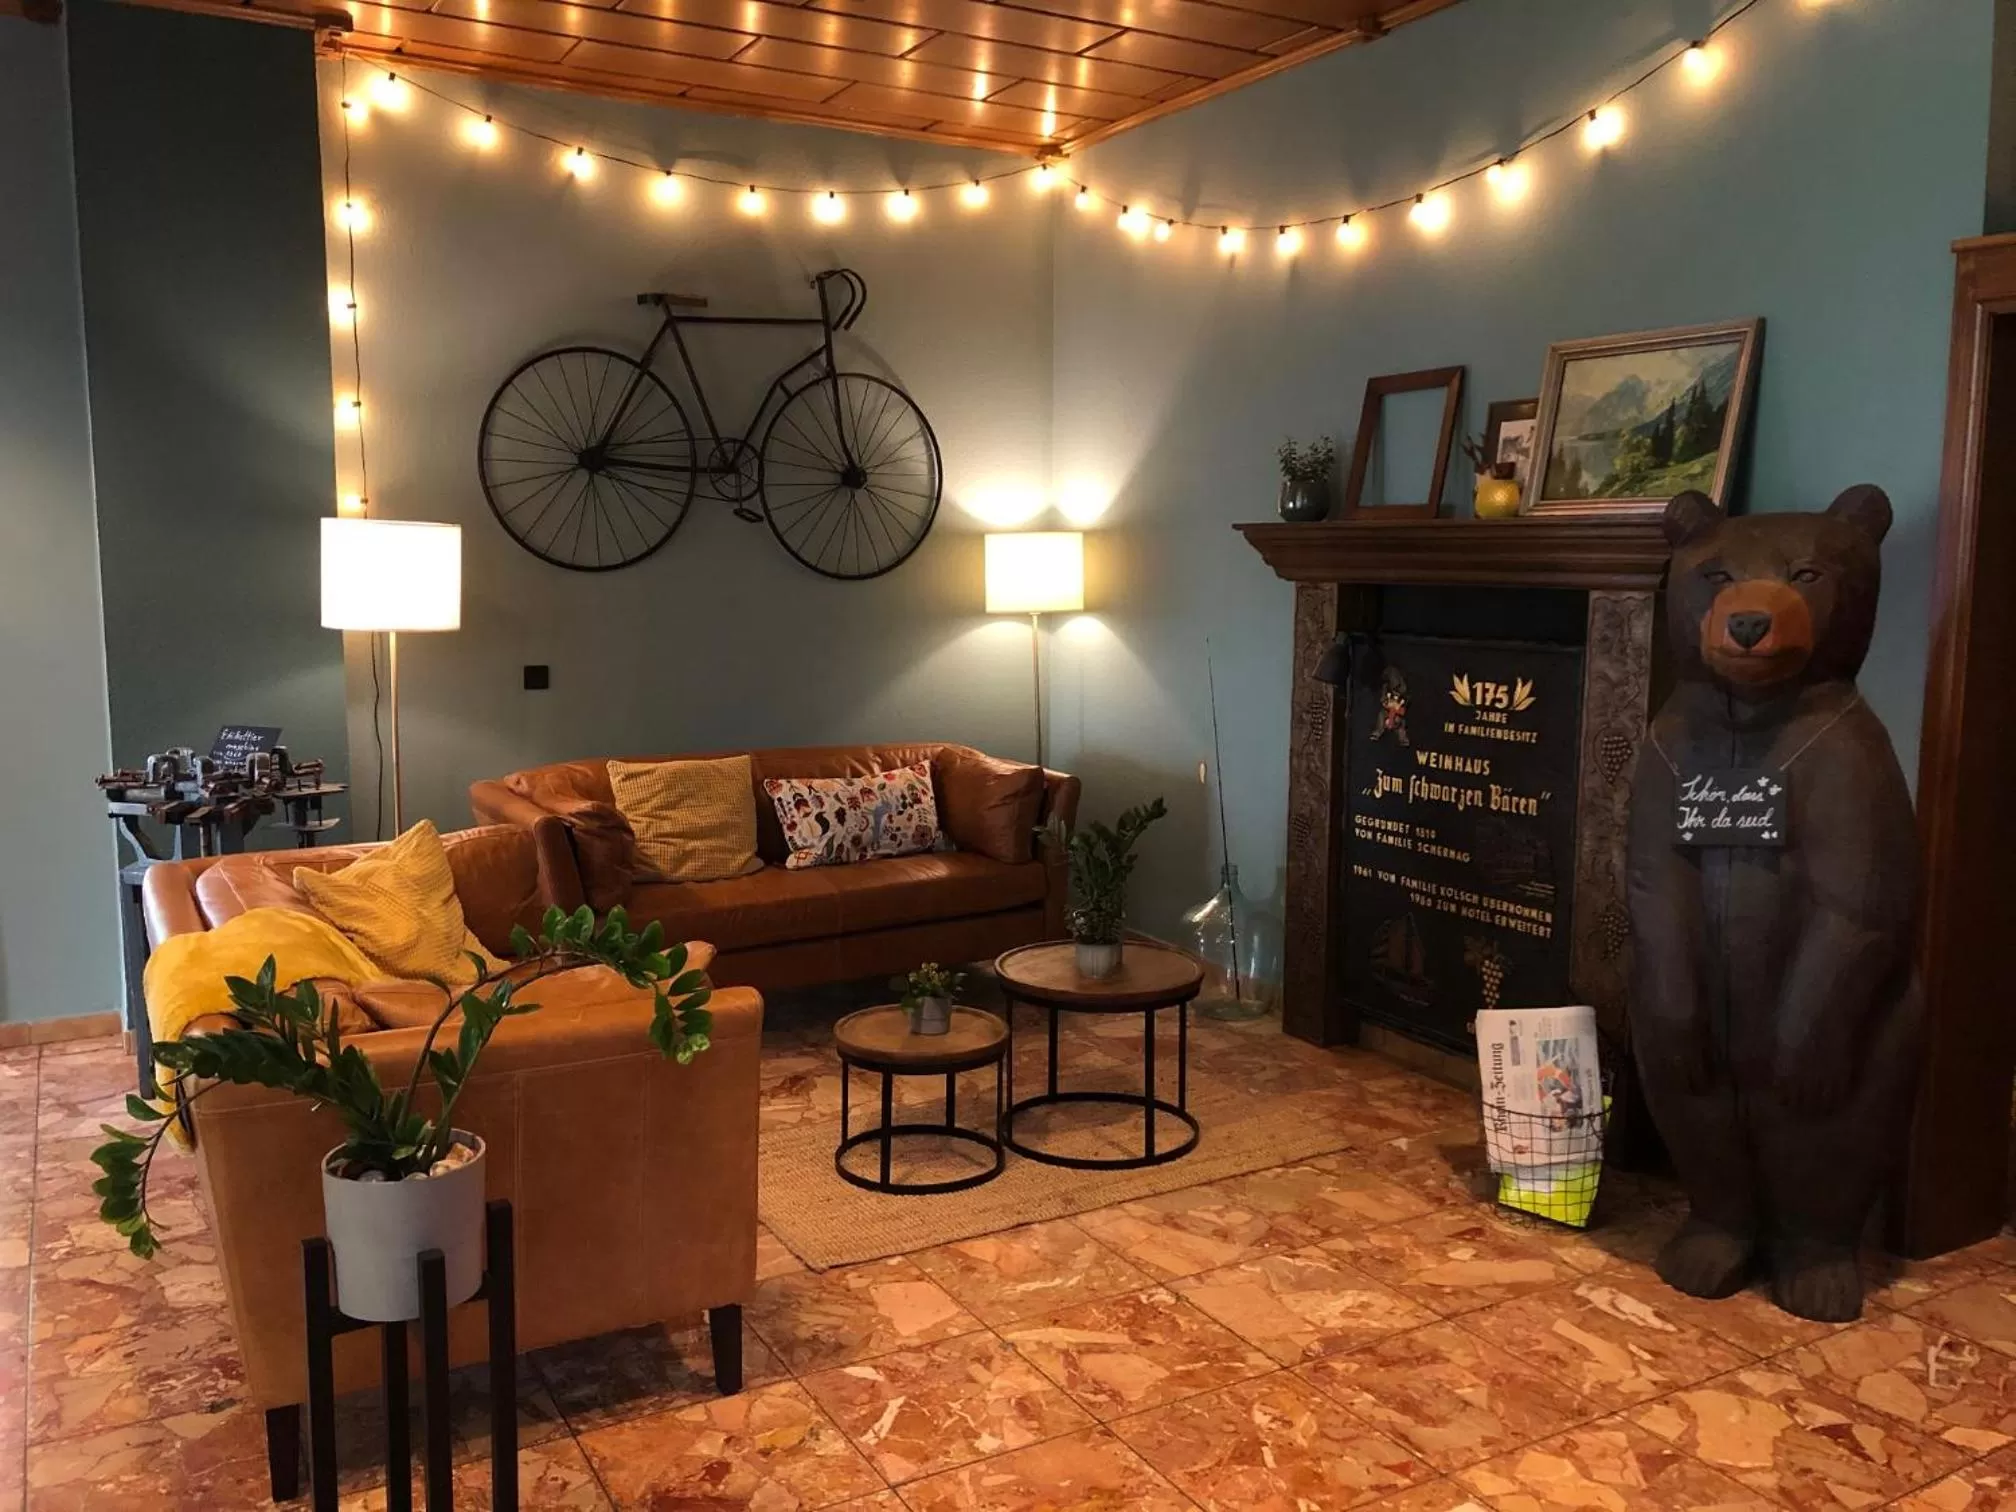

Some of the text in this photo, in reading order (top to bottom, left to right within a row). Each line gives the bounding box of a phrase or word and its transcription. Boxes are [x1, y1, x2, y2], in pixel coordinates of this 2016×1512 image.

[1472, 681, 1509, 709] 175
[1475, 710, 1509, 725] JAHRE
[1458, 724, 1538, 743] FAMILIENBESITZ
[1416, 750, 1491, 776] WEINHAUS
[1677, 806, 1706, 829] Ihr
[1711, 806, 1733, 829] da
[1354, 827, 1374, 841] VON
[1376, 832, 1414, 851] FAMILIE
[1377, 870, 1397, 884] VON
[1400, 875, 1438, 895] FAMILIE
